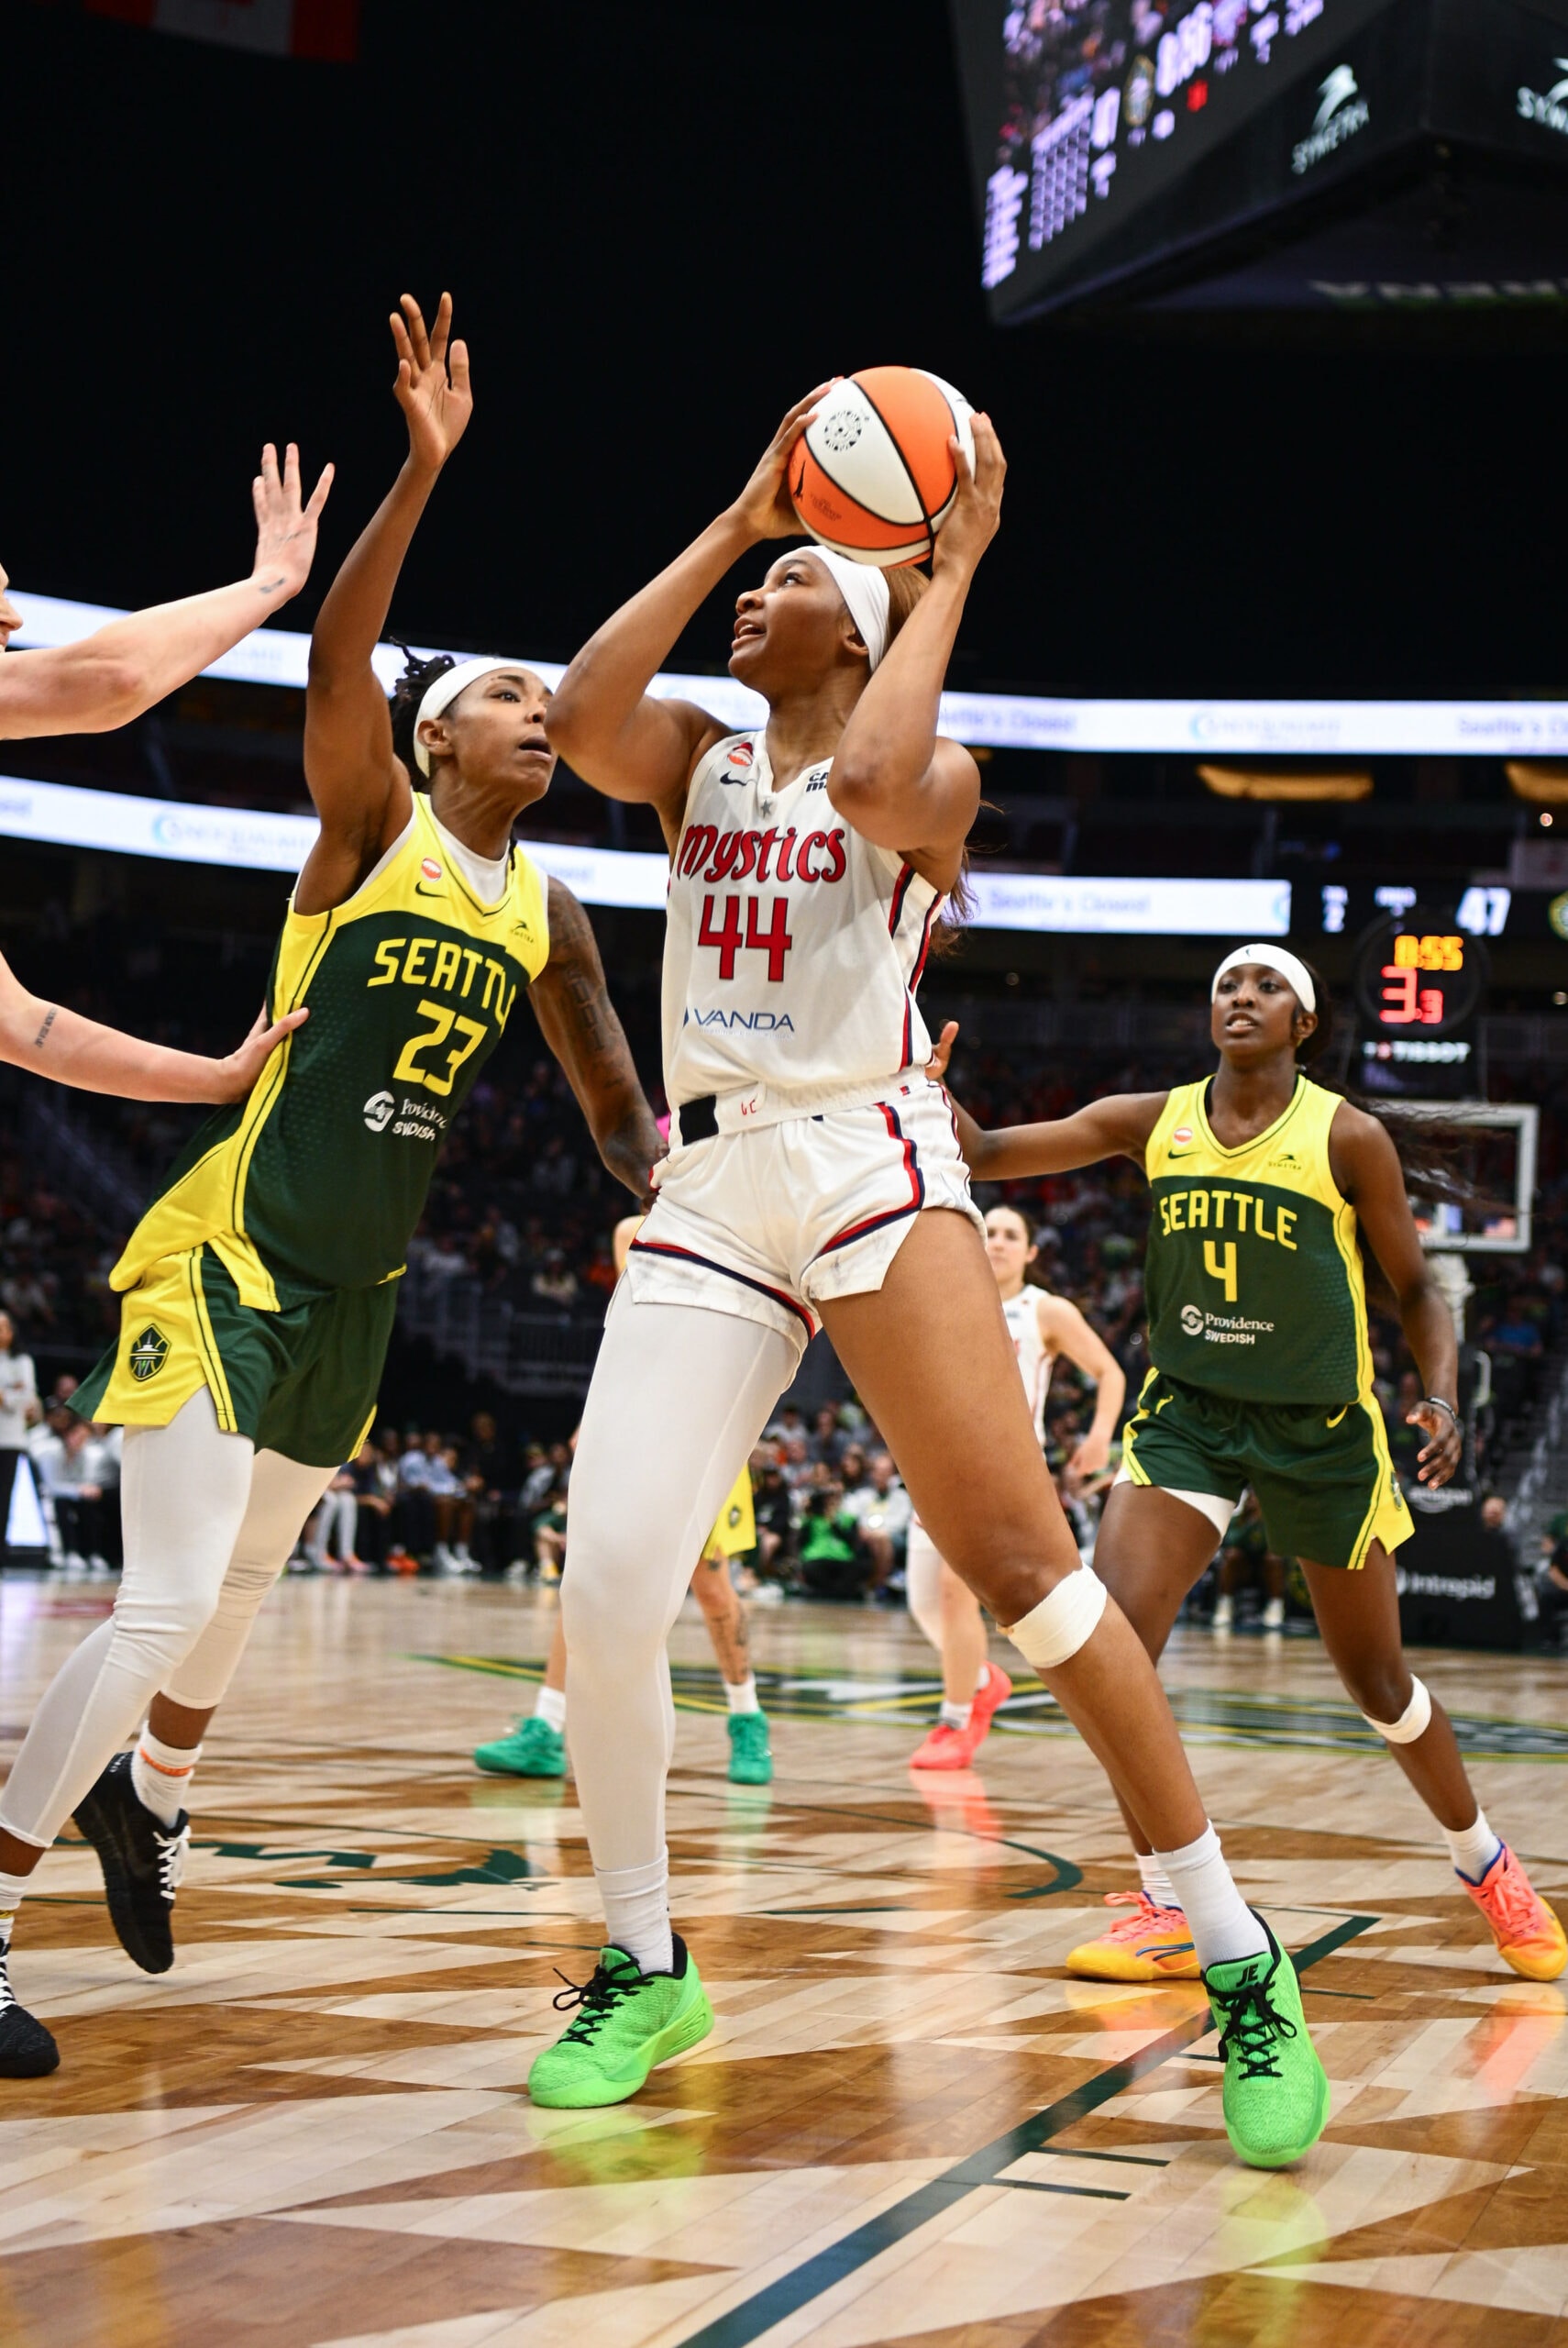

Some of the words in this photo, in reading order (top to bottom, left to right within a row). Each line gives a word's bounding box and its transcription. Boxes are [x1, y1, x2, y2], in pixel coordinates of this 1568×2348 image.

[698, 895, 792, 982] 44
[1456, 887, 1511, 936] 47
[392, 999, 488, 1097] 23
[694, 1008, 795, 1033] VANDA
[1159, 1190, 1297, 1251] SEATTLE
[1203, 1240, 1238, 1302] 4
[1204, 1329, 1255, 1345] SWEDISH
[1205, 1312, 1275, 1332] Providence
